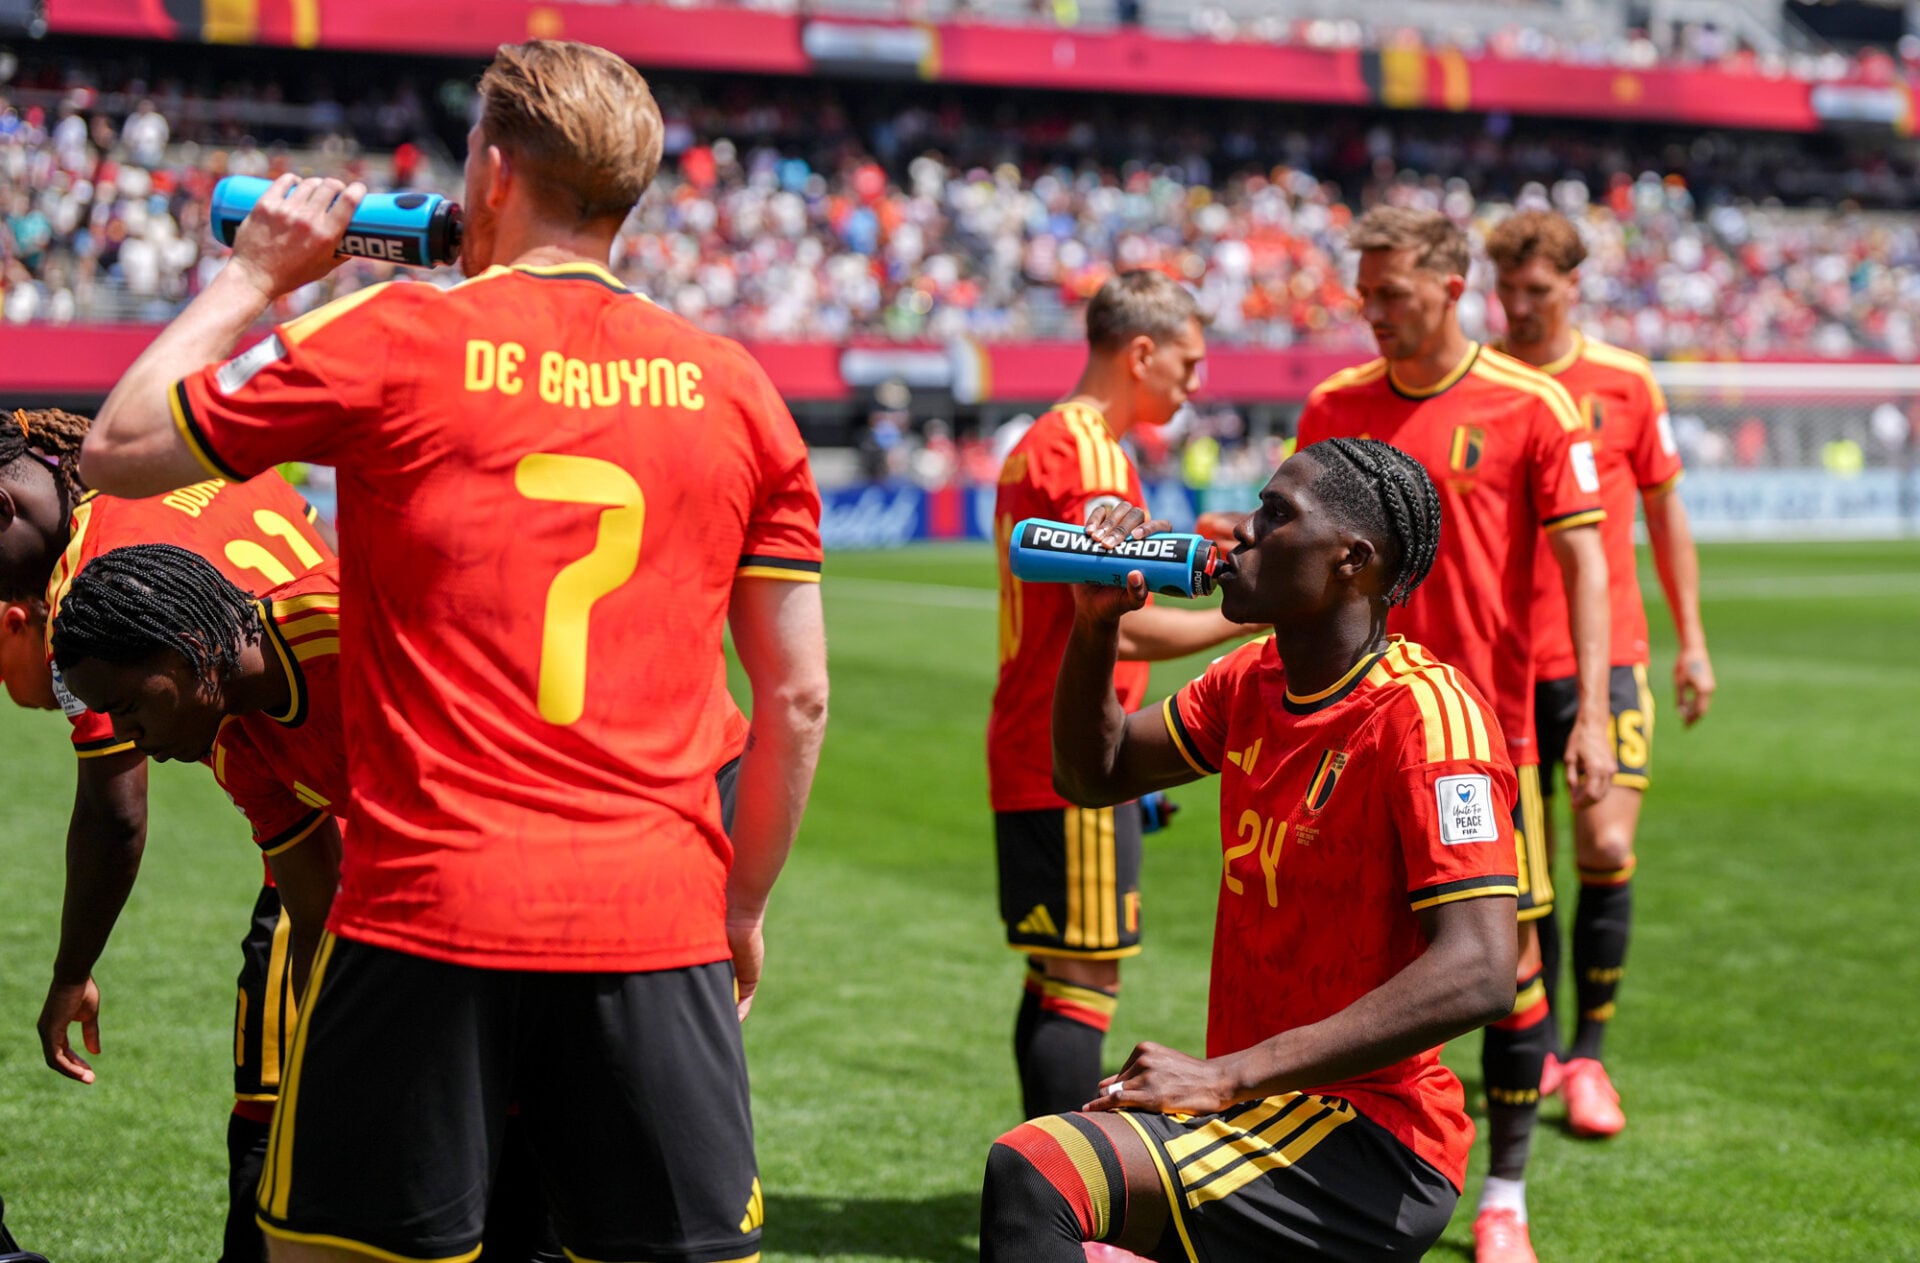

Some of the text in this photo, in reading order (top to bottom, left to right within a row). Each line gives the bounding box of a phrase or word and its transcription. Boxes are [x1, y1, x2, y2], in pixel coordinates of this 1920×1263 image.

[464, 339, 705, 411] DE BRUYNE
[514, 452, 646, 726] 7
[1455, 815, 1482, 829] PEACE
[1462, 828, 1478, 836] FIFA
[1224, 809, 1288, 908] 24
